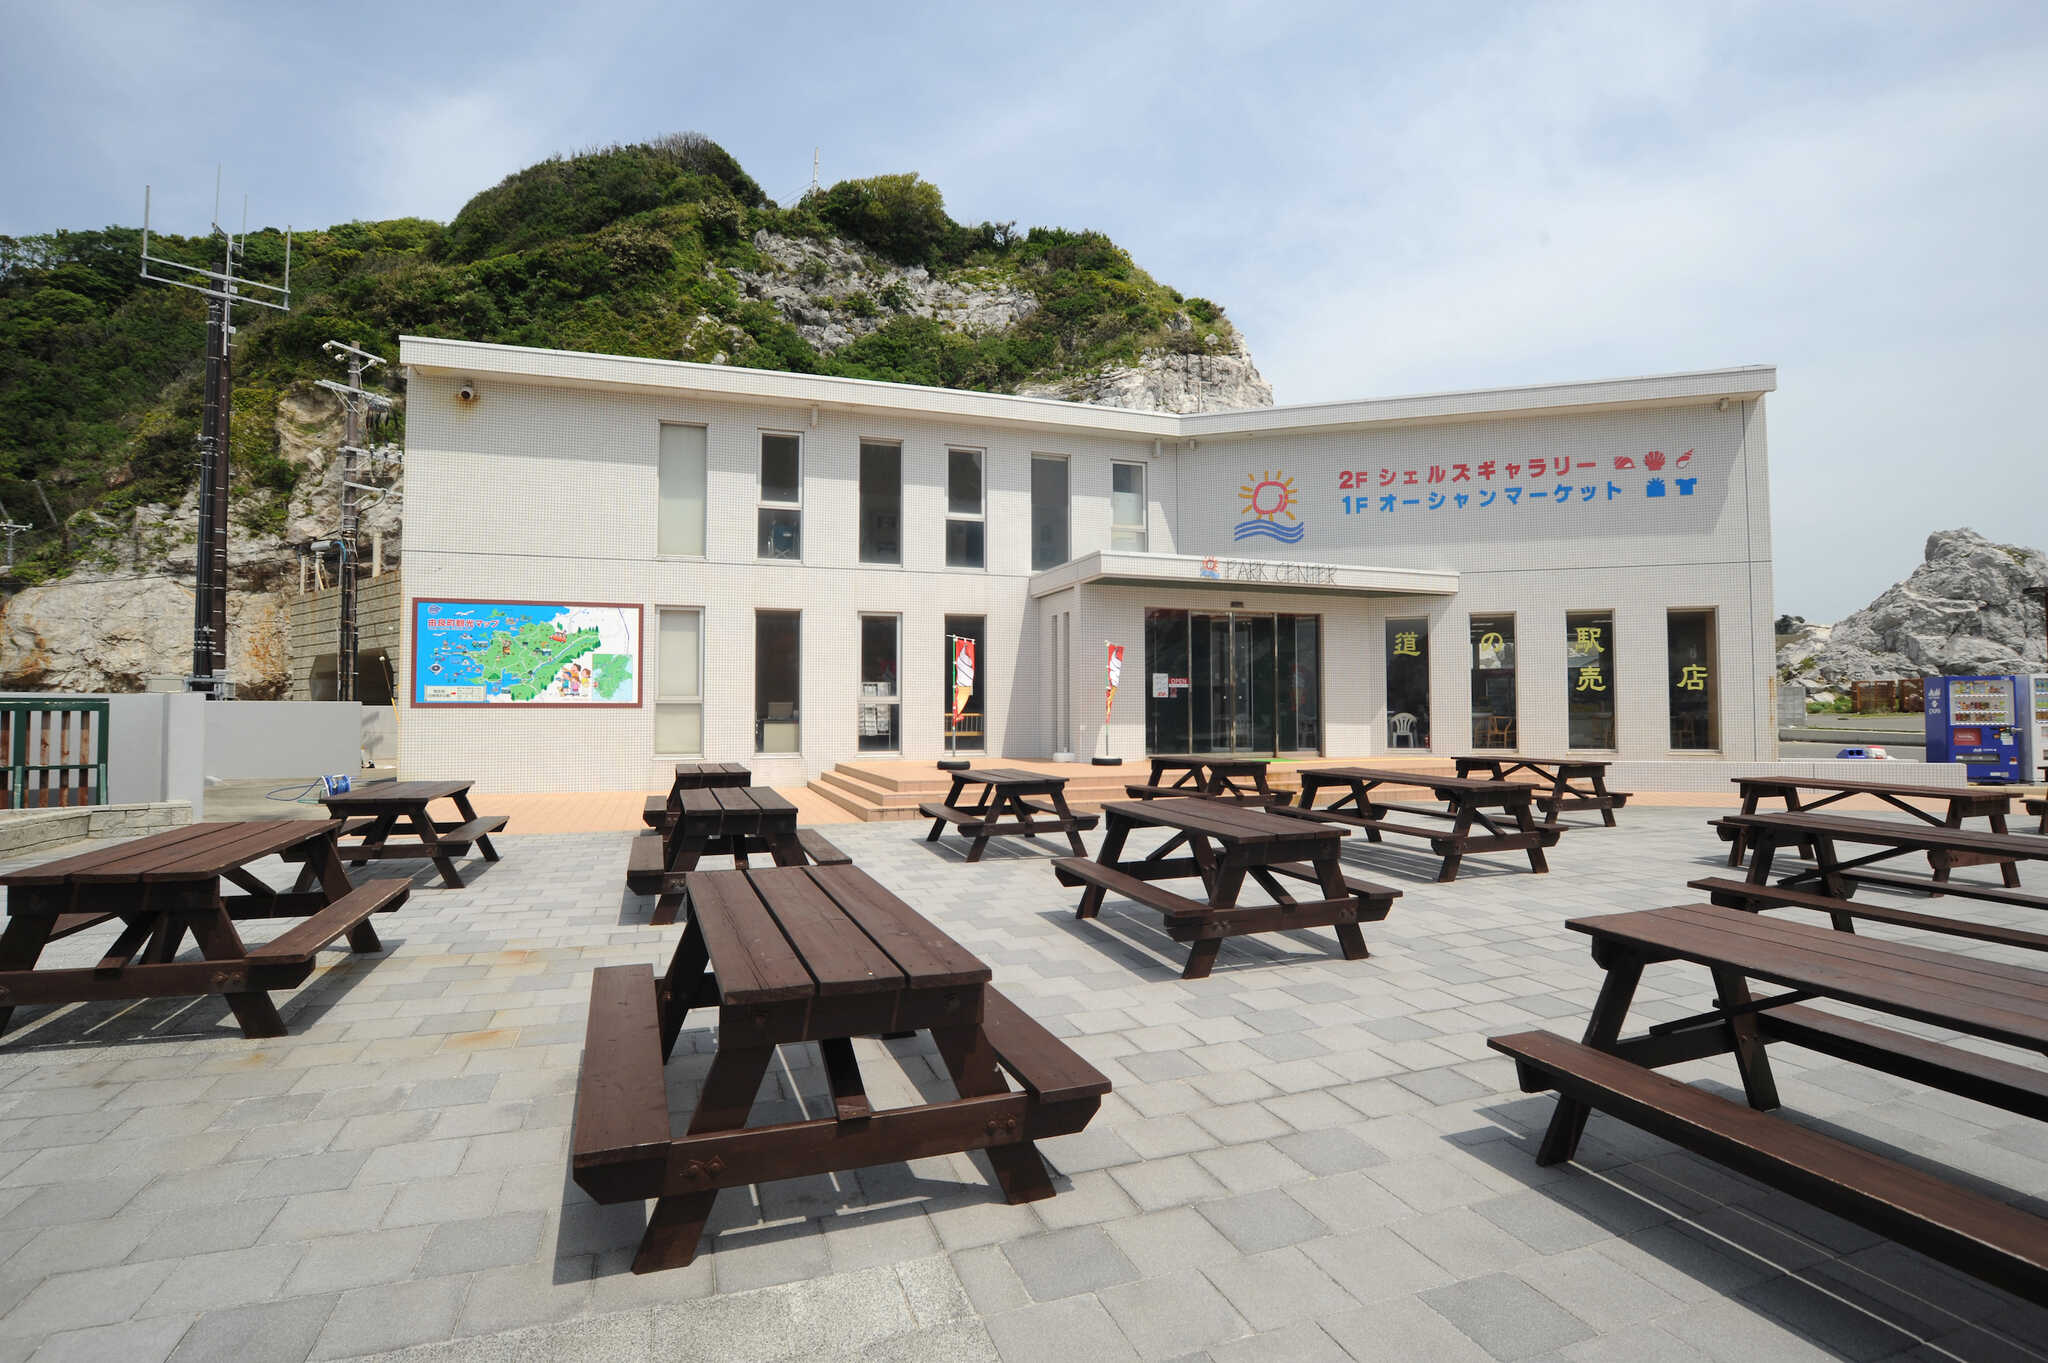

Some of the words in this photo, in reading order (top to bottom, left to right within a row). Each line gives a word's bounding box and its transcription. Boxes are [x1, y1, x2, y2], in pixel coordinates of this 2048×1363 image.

[1339, 470, 1368, 489] 2F
[1342, 495, 1369, 515] 1F
[1379, 480, 1622, 513] オーシャンマーケット
[1225, 560, 1269, 581] PARK
[1275, 563, 1337, 585] CENTER
